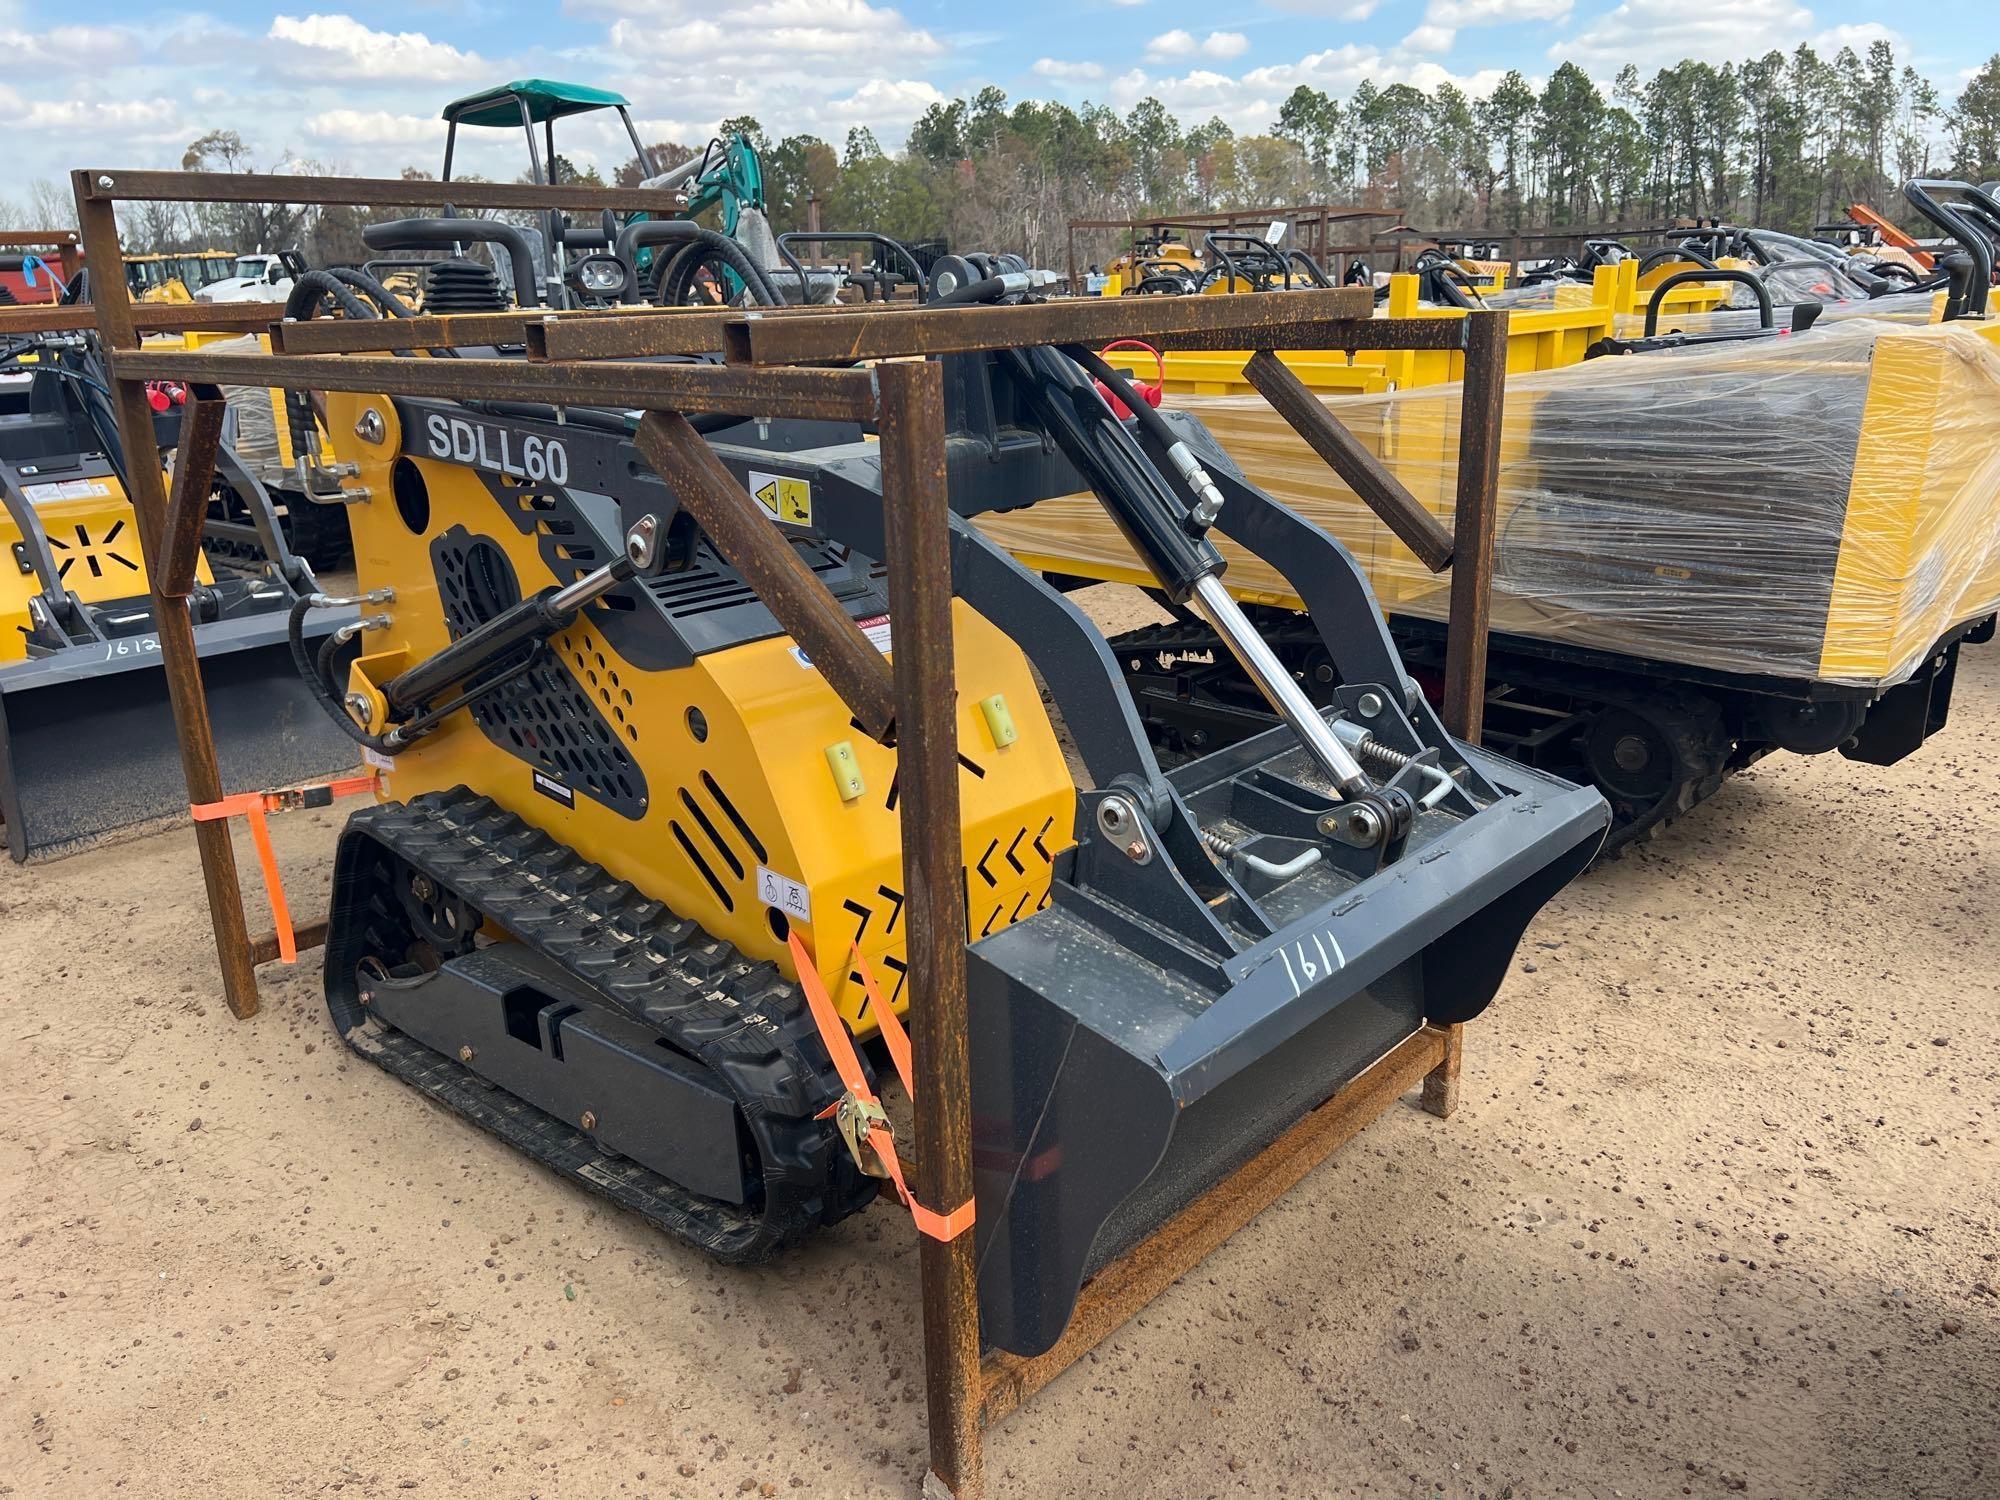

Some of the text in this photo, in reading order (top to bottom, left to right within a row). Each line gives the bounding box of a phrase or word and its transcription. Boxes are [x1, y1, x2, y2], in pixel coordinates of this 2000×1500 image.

[428, 414, 568, 486] SDLL60
[860, 615, 887, 628] DANGER
[106, 638, 161, 660] 1612
[1279, 930, 1346, 998] 1611
